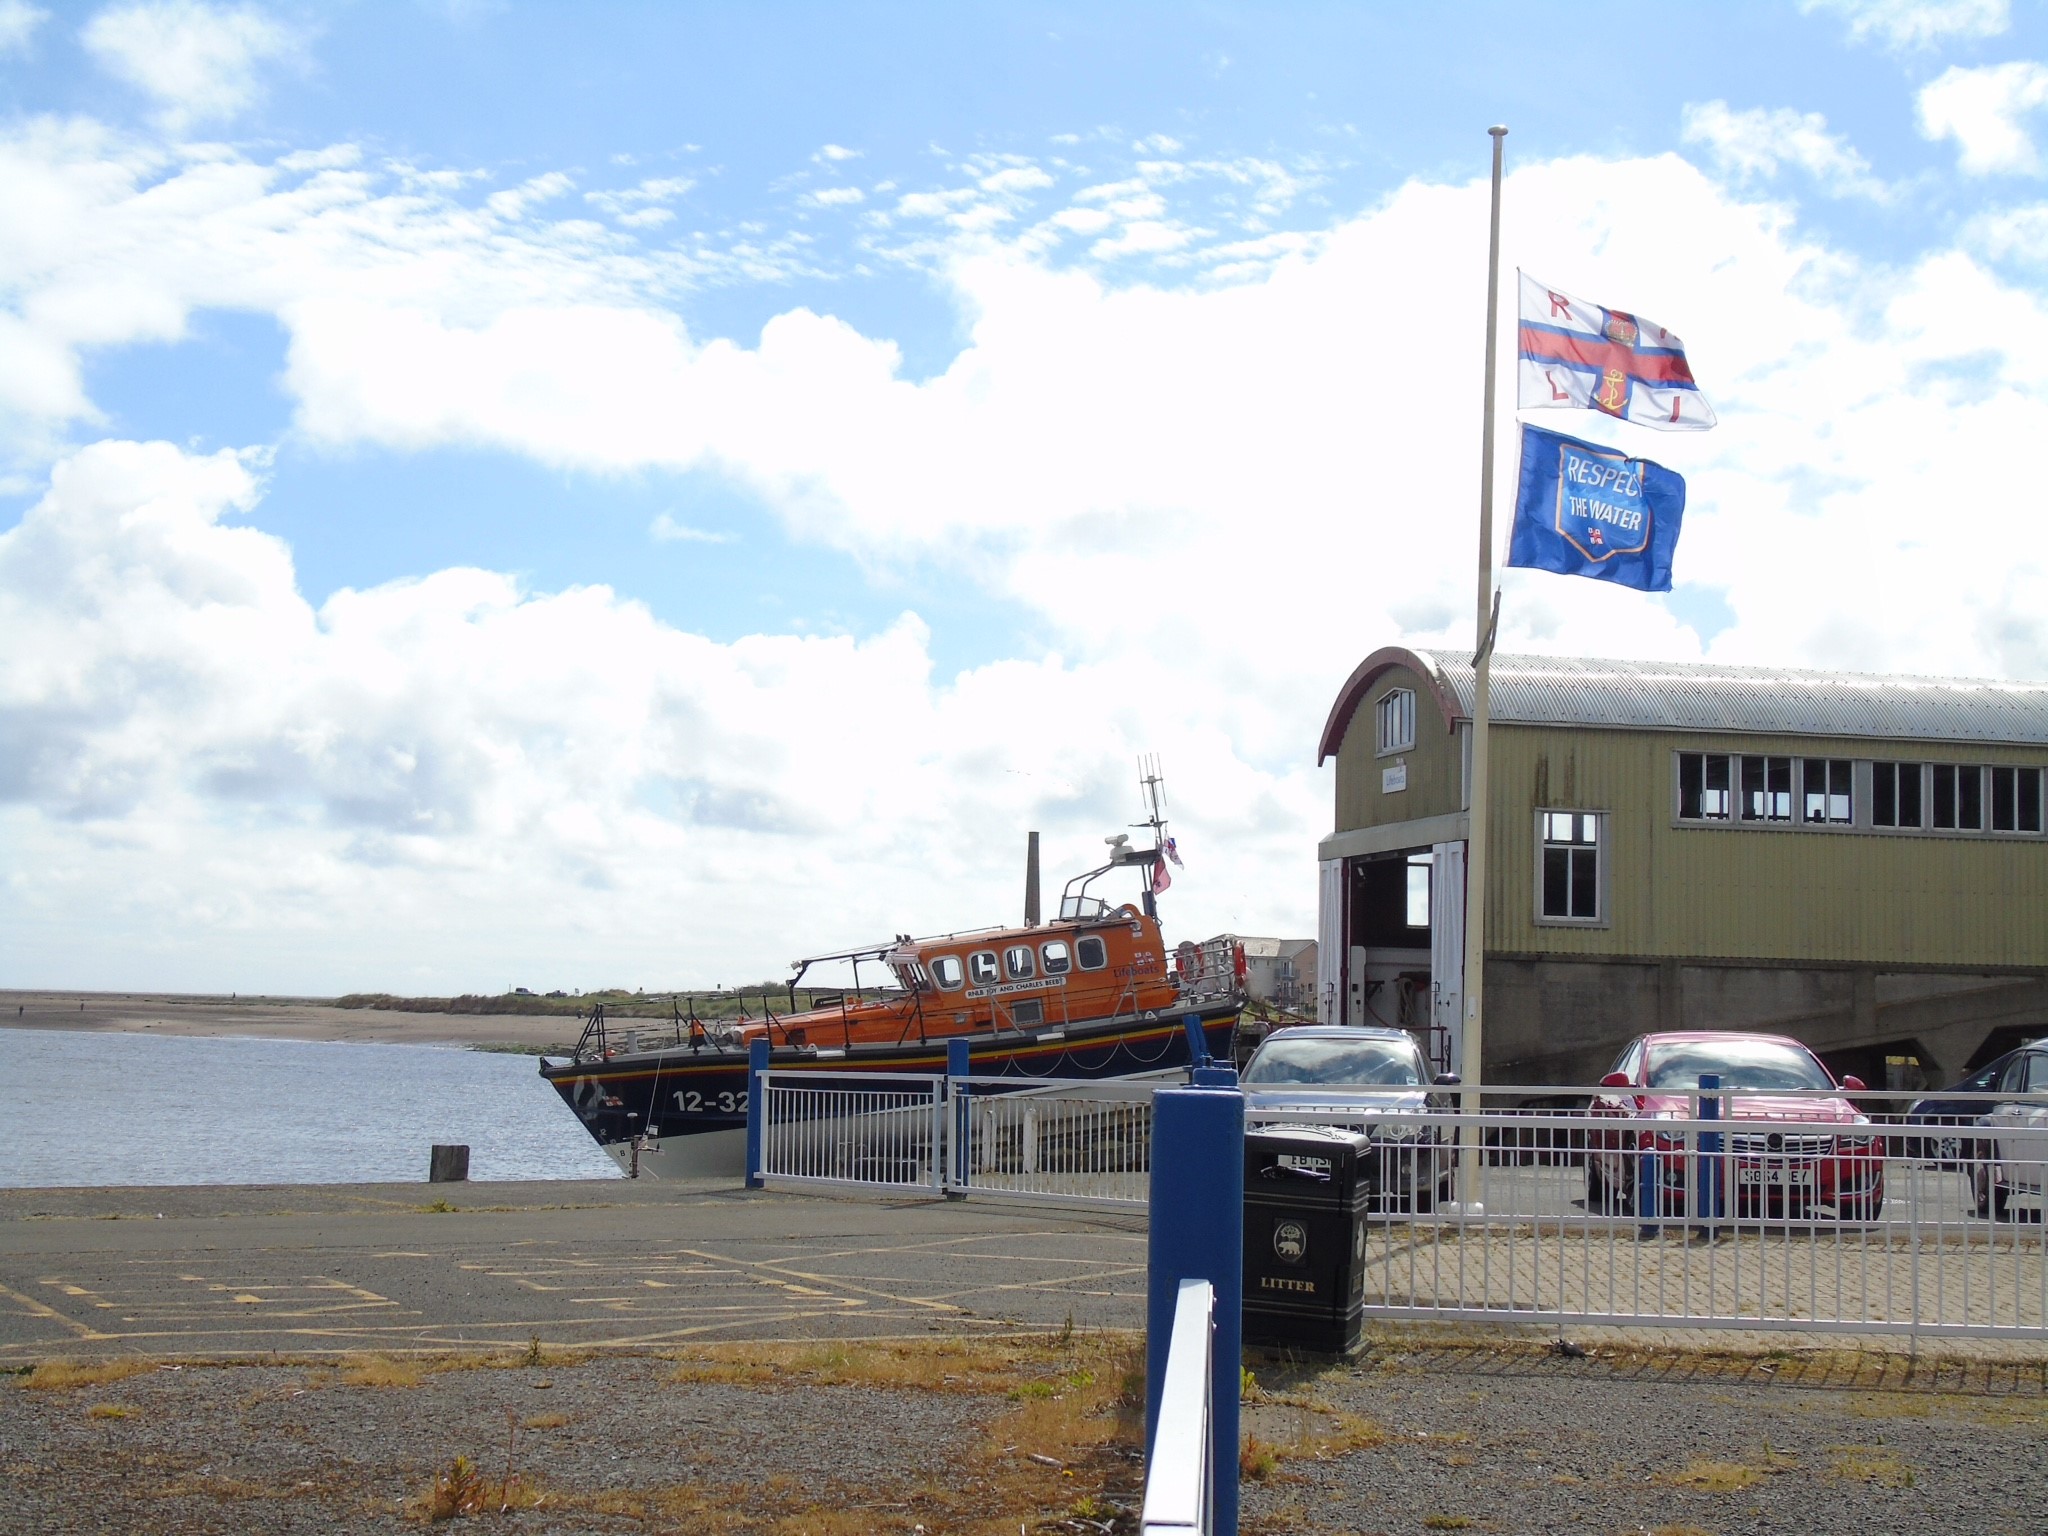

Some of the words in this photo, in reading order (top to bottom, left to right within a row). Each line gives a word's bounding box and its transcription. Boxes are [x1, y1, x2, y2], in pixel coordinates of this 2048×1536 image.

[1547, 289, 1572, 321] R
[1545, 370, 1569, 401] L
[1569, 496, 1588, 518] THE
[1589, 499, 1642, 531] WATER
[1113, 964, 1160, 978] Lifeboats
[967, 989, 984, 998] RNLB
[1000, 984, 1014, 993] AND
[1016, 980, 1043, 990] CHARLES
[672, 1090, 748, 1113] 12-32
[1261, 1277, 1315, 1292] LITTER
